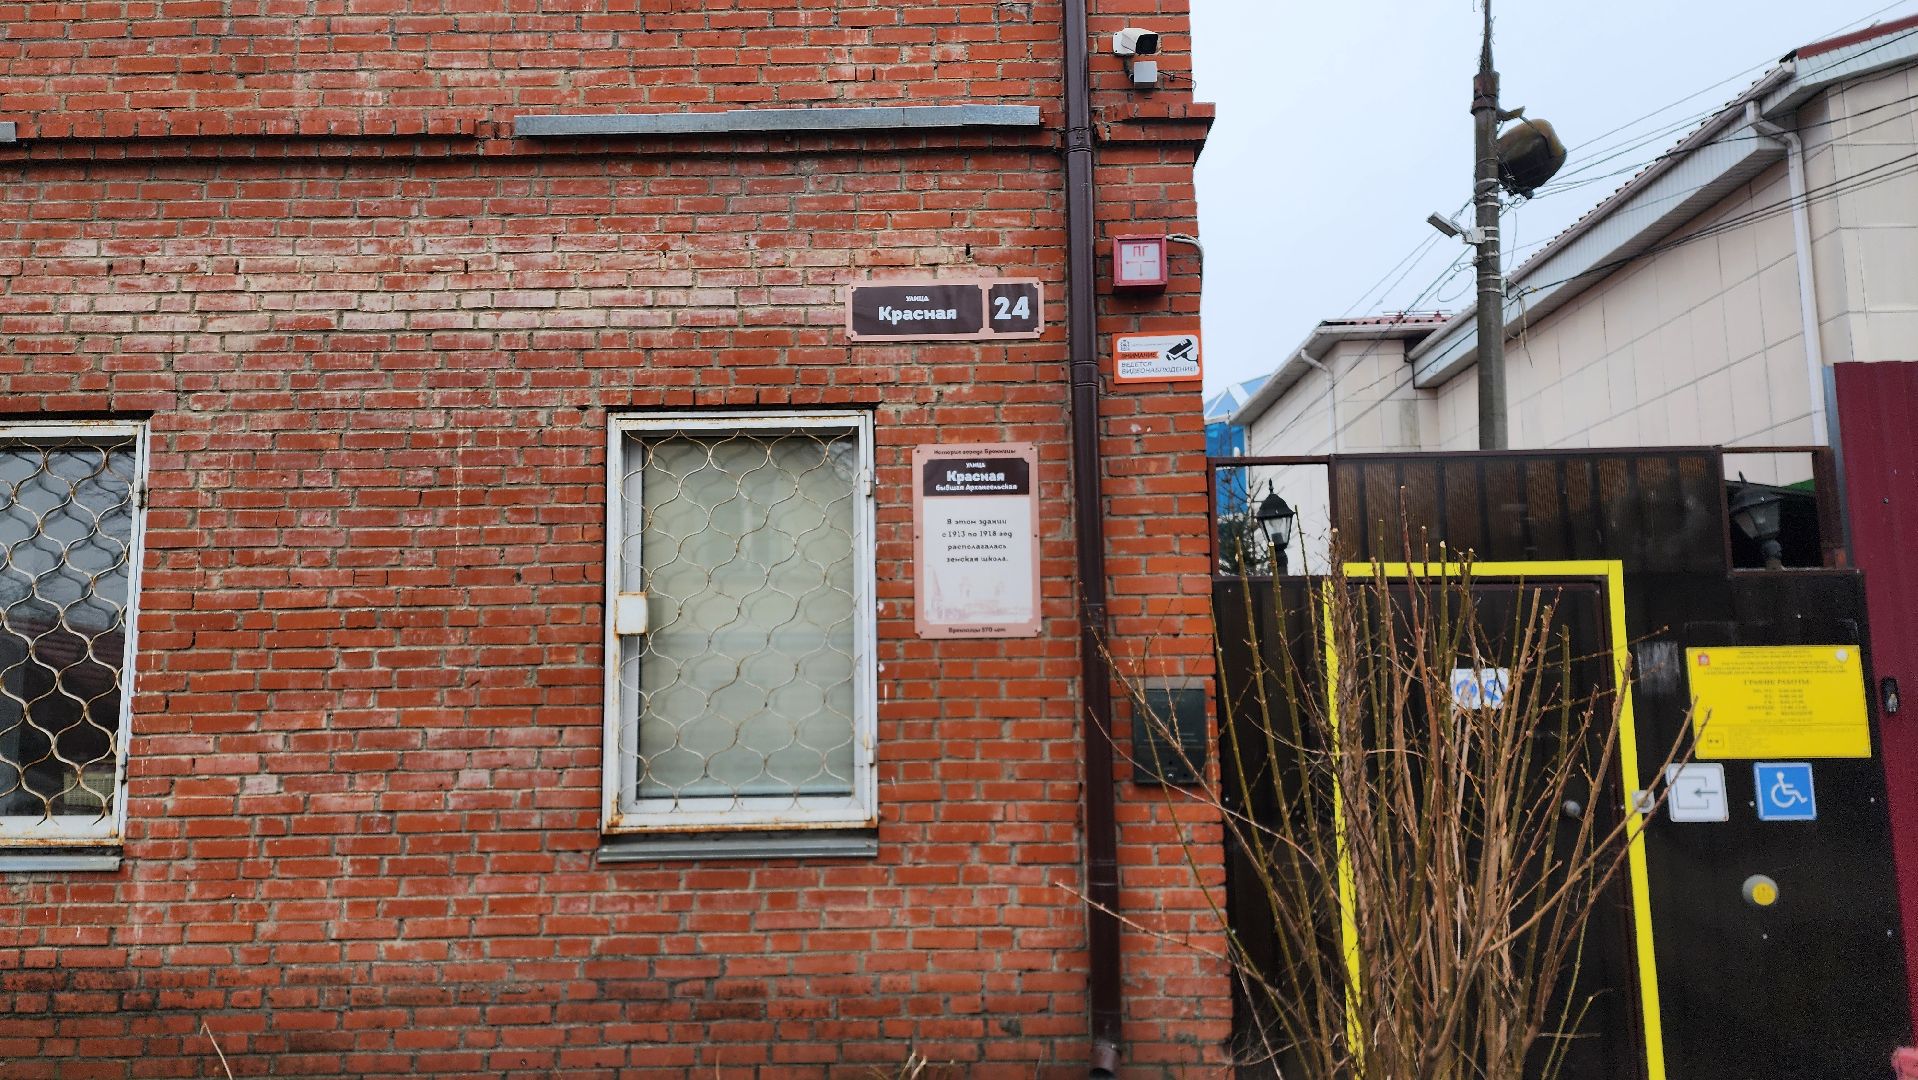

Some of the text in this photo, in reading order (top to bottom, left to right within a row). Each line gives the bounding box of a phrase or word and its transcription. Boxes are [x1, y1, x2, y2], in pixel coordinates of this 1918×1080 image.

[1133, 245, 1149, 257] ПГ
[878, 295, 1030, 325] Красная 24
[946, 470, 1005, 484] Красная
[935, 483, 1018, 492] бывшая Архангельская
[999, 531, 1013, 539] год
